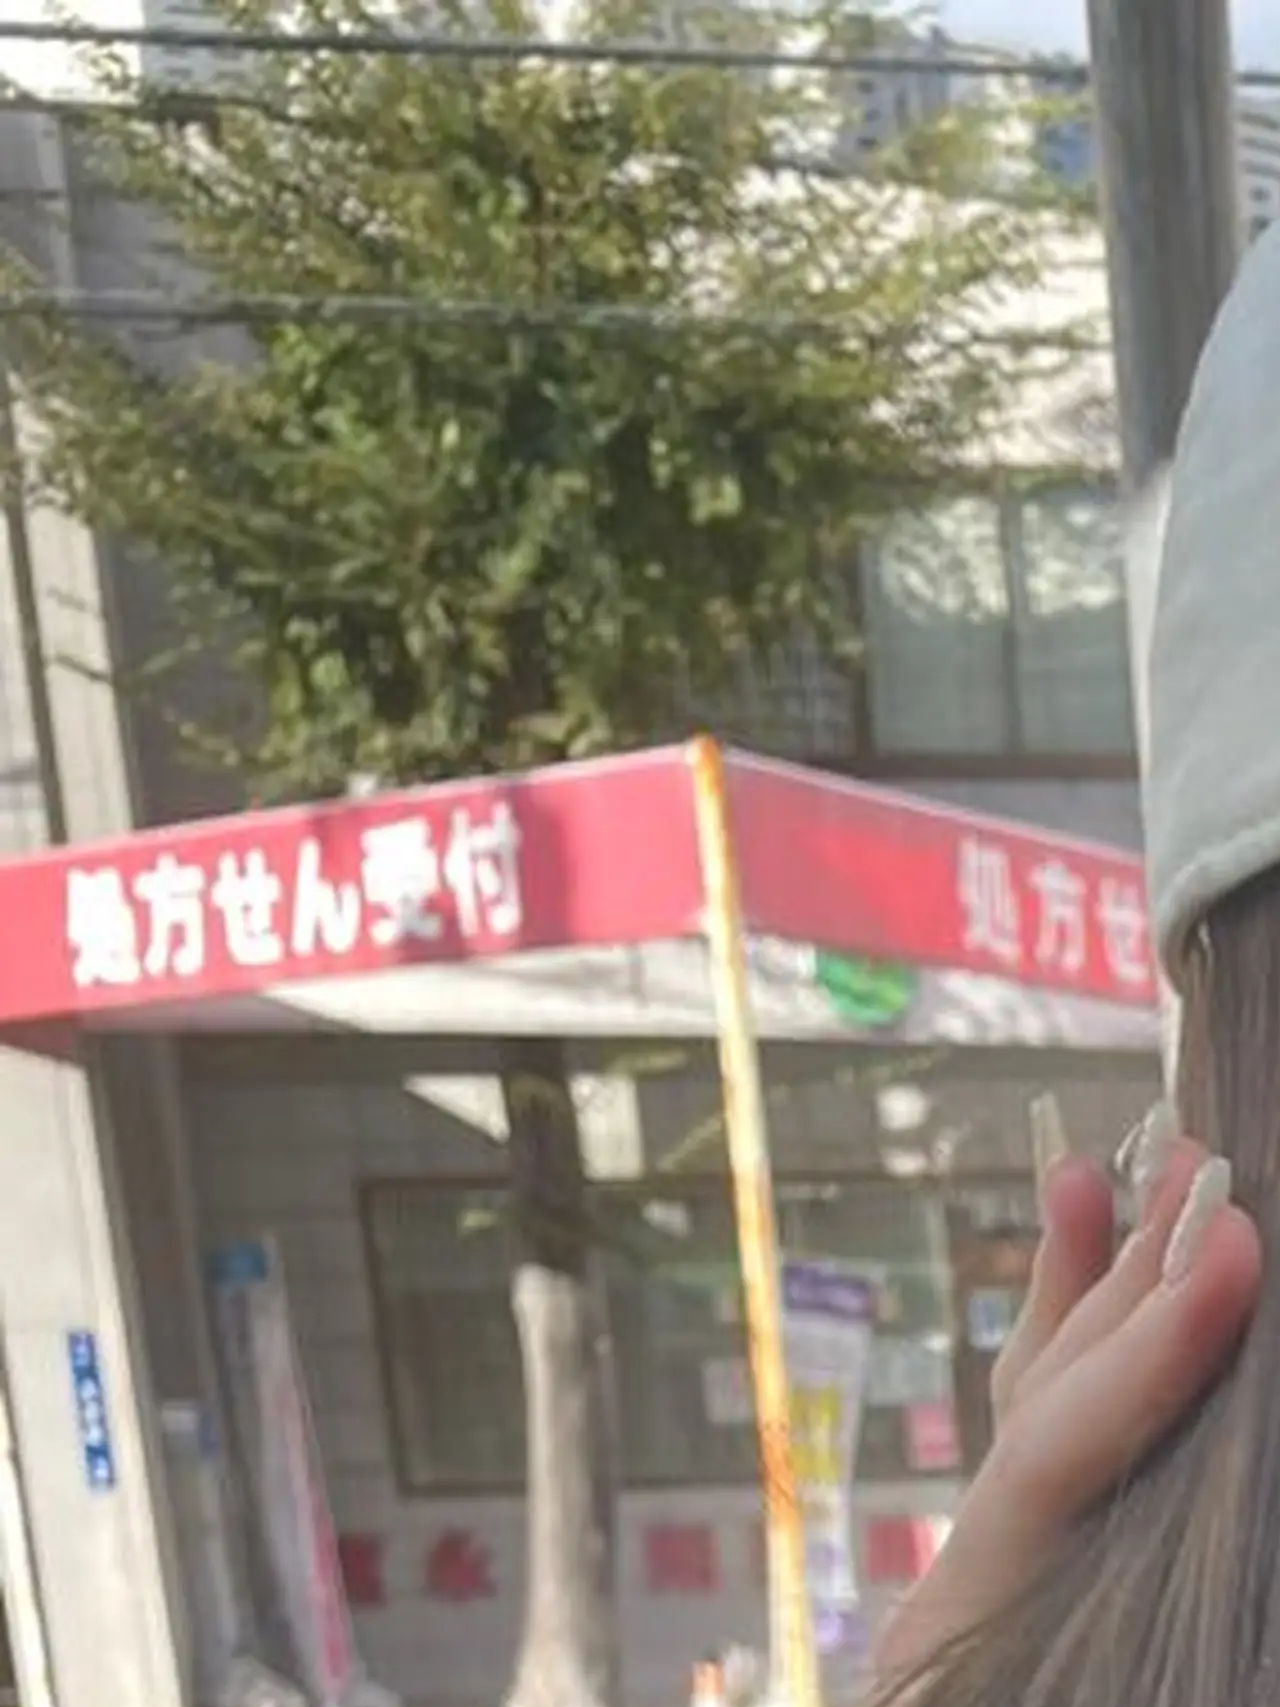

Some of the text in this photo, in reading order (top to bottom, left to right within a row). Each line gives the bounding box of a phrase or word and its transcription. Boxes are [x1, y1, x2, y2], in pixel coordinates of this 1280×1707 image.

[67, 800, 523, 987] 処方せん受付
